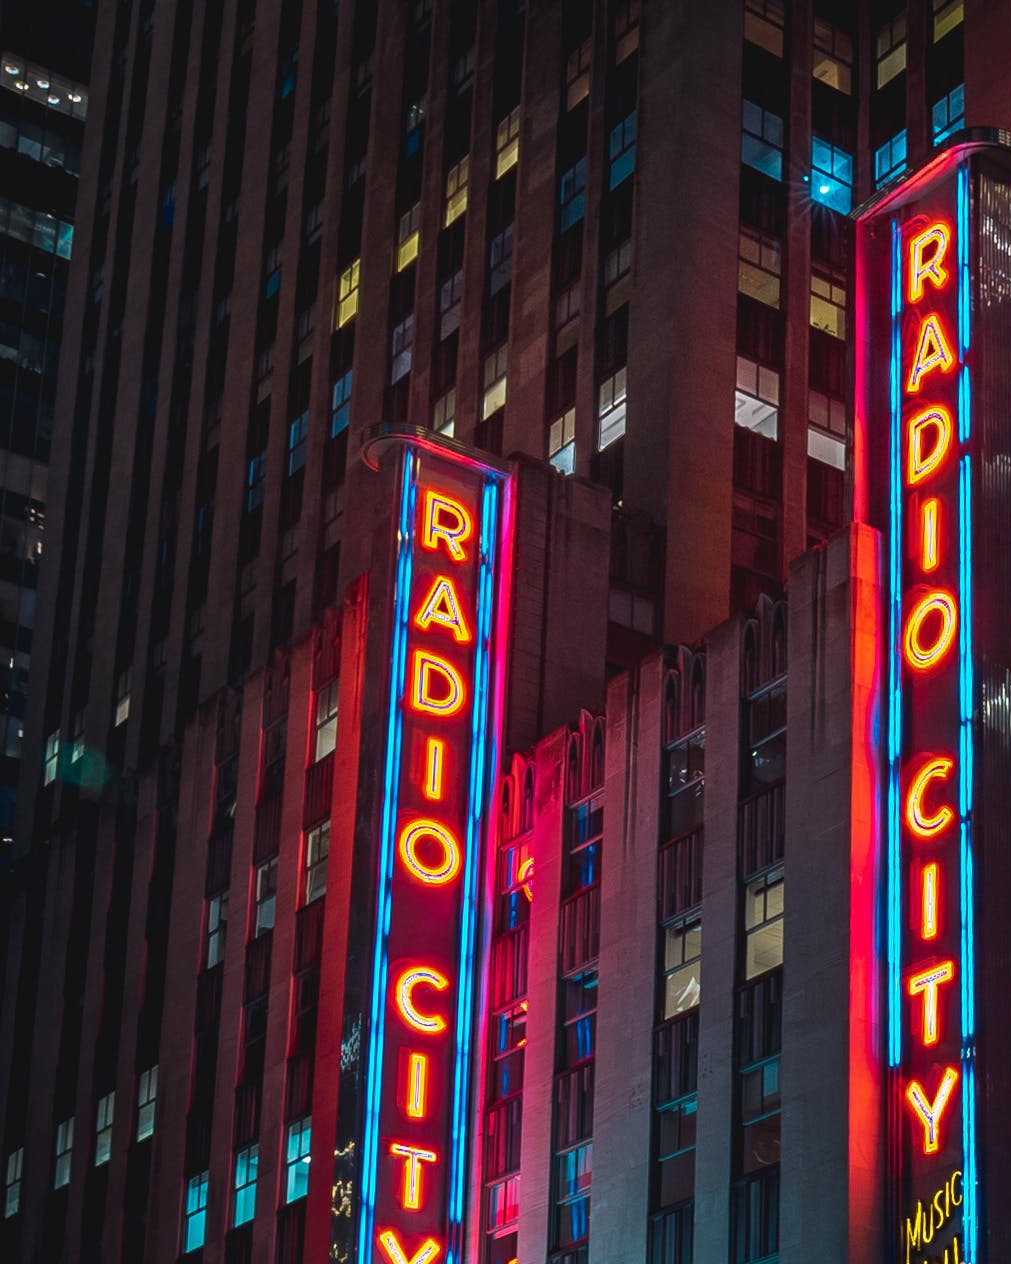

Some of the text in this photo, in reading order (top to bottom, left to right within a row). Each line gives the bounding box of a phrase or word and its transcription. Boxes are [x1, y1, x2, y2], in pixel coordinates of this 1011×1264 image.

[398, 490, 474, 887] RADIO
[904, 222, 959, 1155] RADIO CITY
